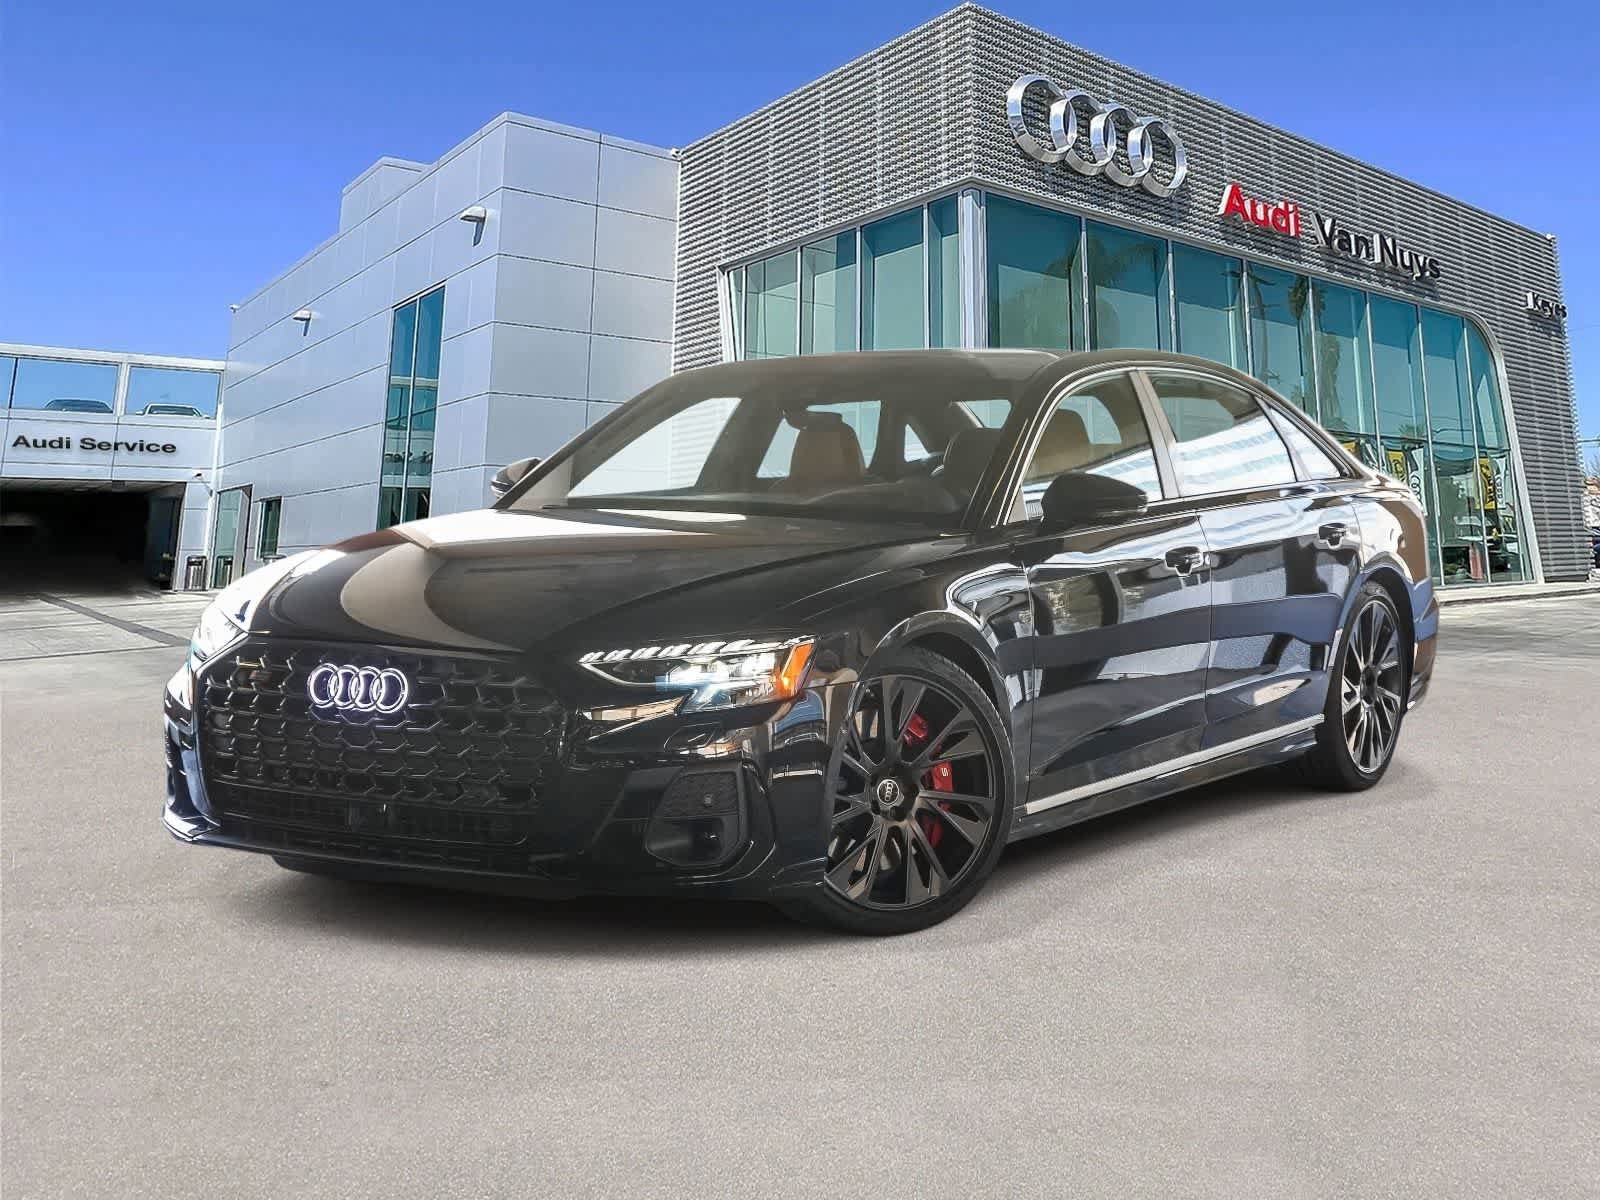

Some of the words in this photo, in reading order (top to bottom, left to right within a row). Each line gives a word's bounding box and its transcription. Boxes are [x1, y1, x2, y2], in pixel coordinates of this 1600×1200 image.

[1219, 182, 1302, 238] Audi
[1311, 211, 1371, 260] Van
[1373, 233, 1441, 280] Nuys
[12, 435, 71, 450] Audi
[79, 437, 177, 454] Service
